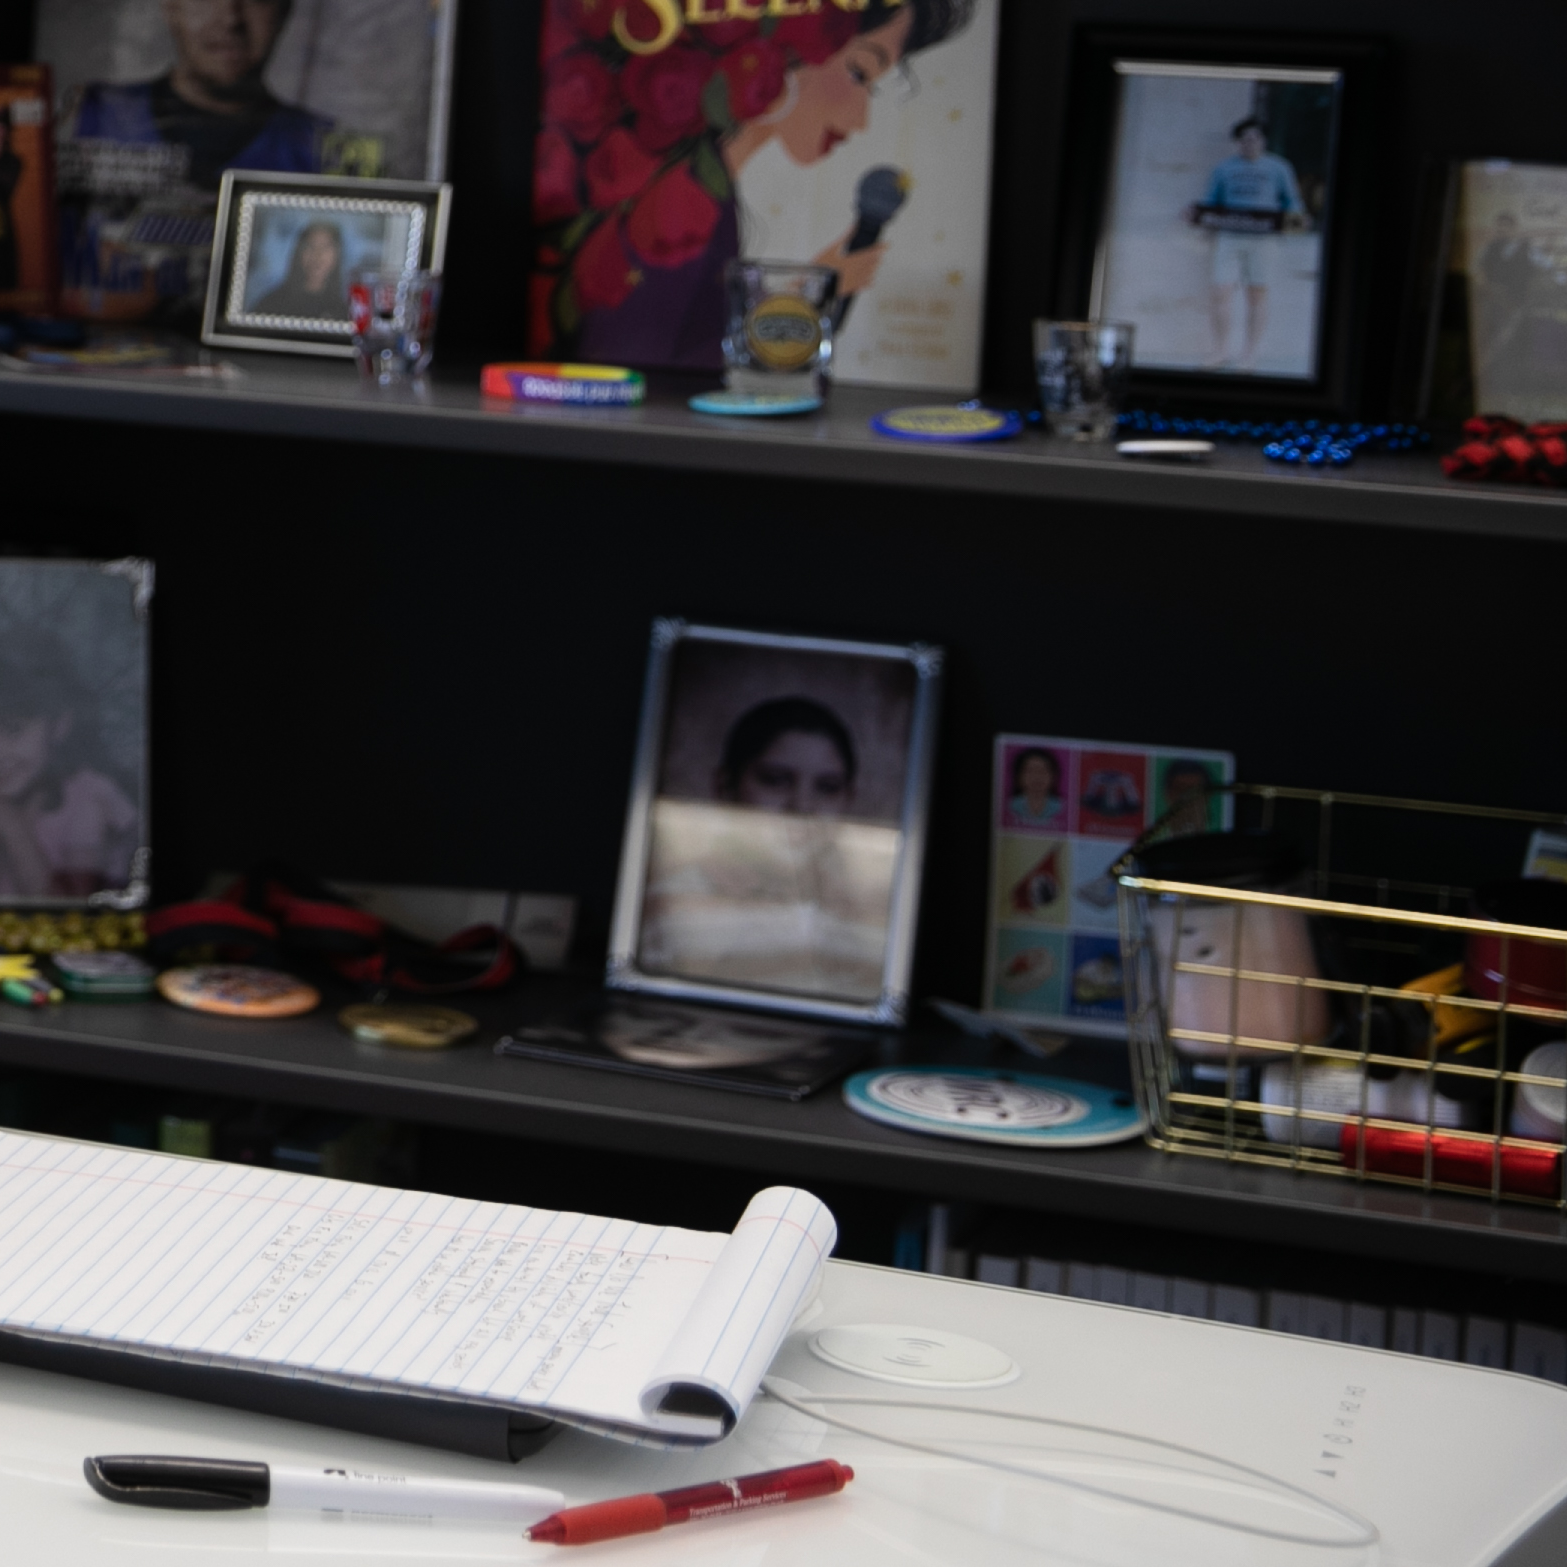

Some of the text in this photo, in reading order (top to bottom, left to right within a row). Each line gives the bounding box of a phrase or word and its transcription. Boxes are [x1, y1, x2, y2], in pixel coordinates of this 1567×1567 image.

[689, 1500, 734, 1518] Transportation
[739, 1494, 763, 1508] Parking
[762, 1490, 788, 1505] Services
